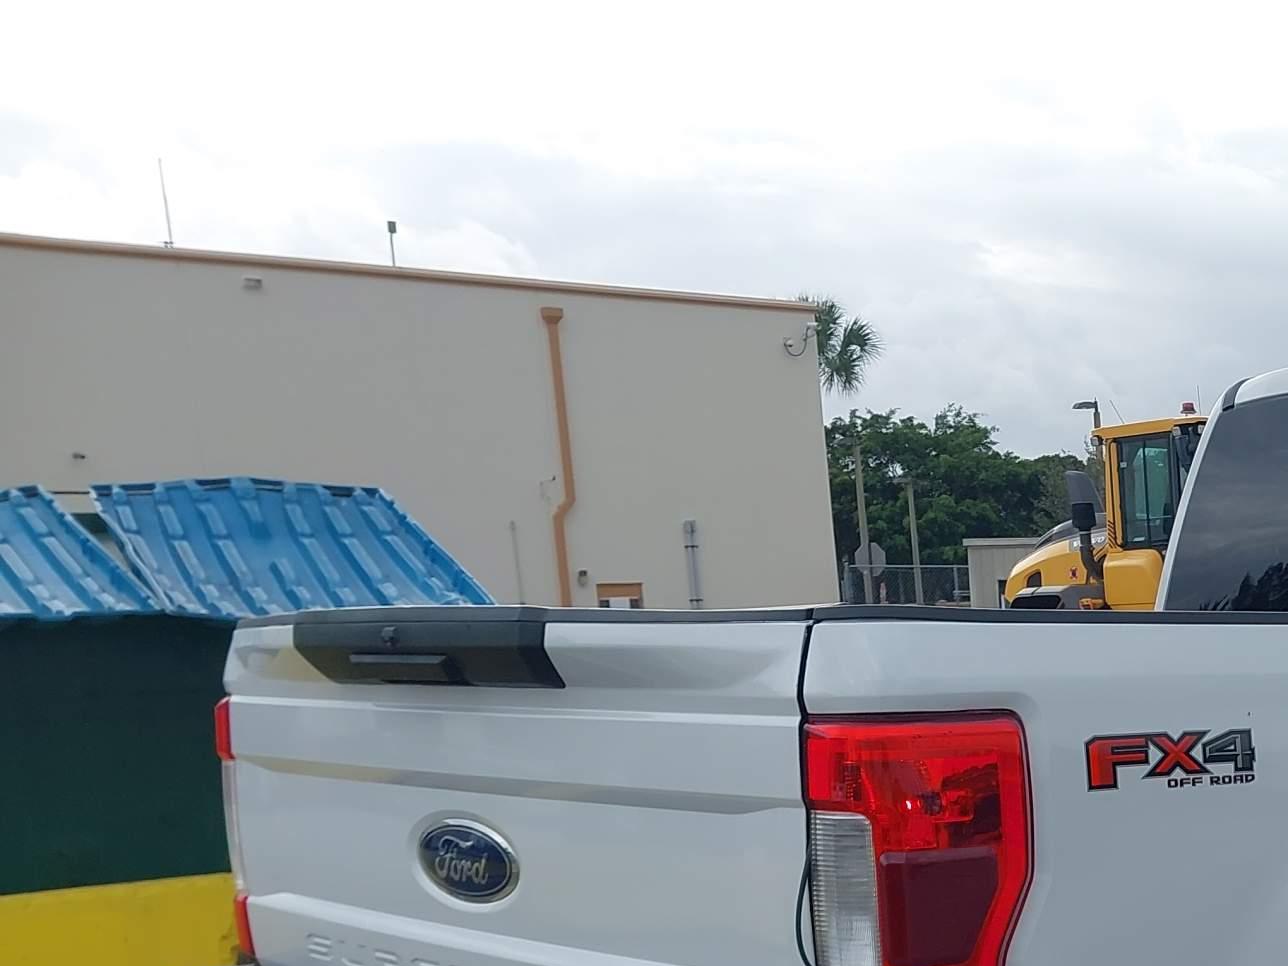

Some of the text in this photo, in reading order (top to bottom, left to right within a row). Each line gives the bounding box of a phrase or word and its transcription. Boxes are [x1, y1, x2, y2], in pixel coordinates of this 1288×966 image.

[1085, 728, 1256, 792] FX4
[1167, 774, 1256, 789] OFF ROAD
[435, 835, 489, 885] Ford
